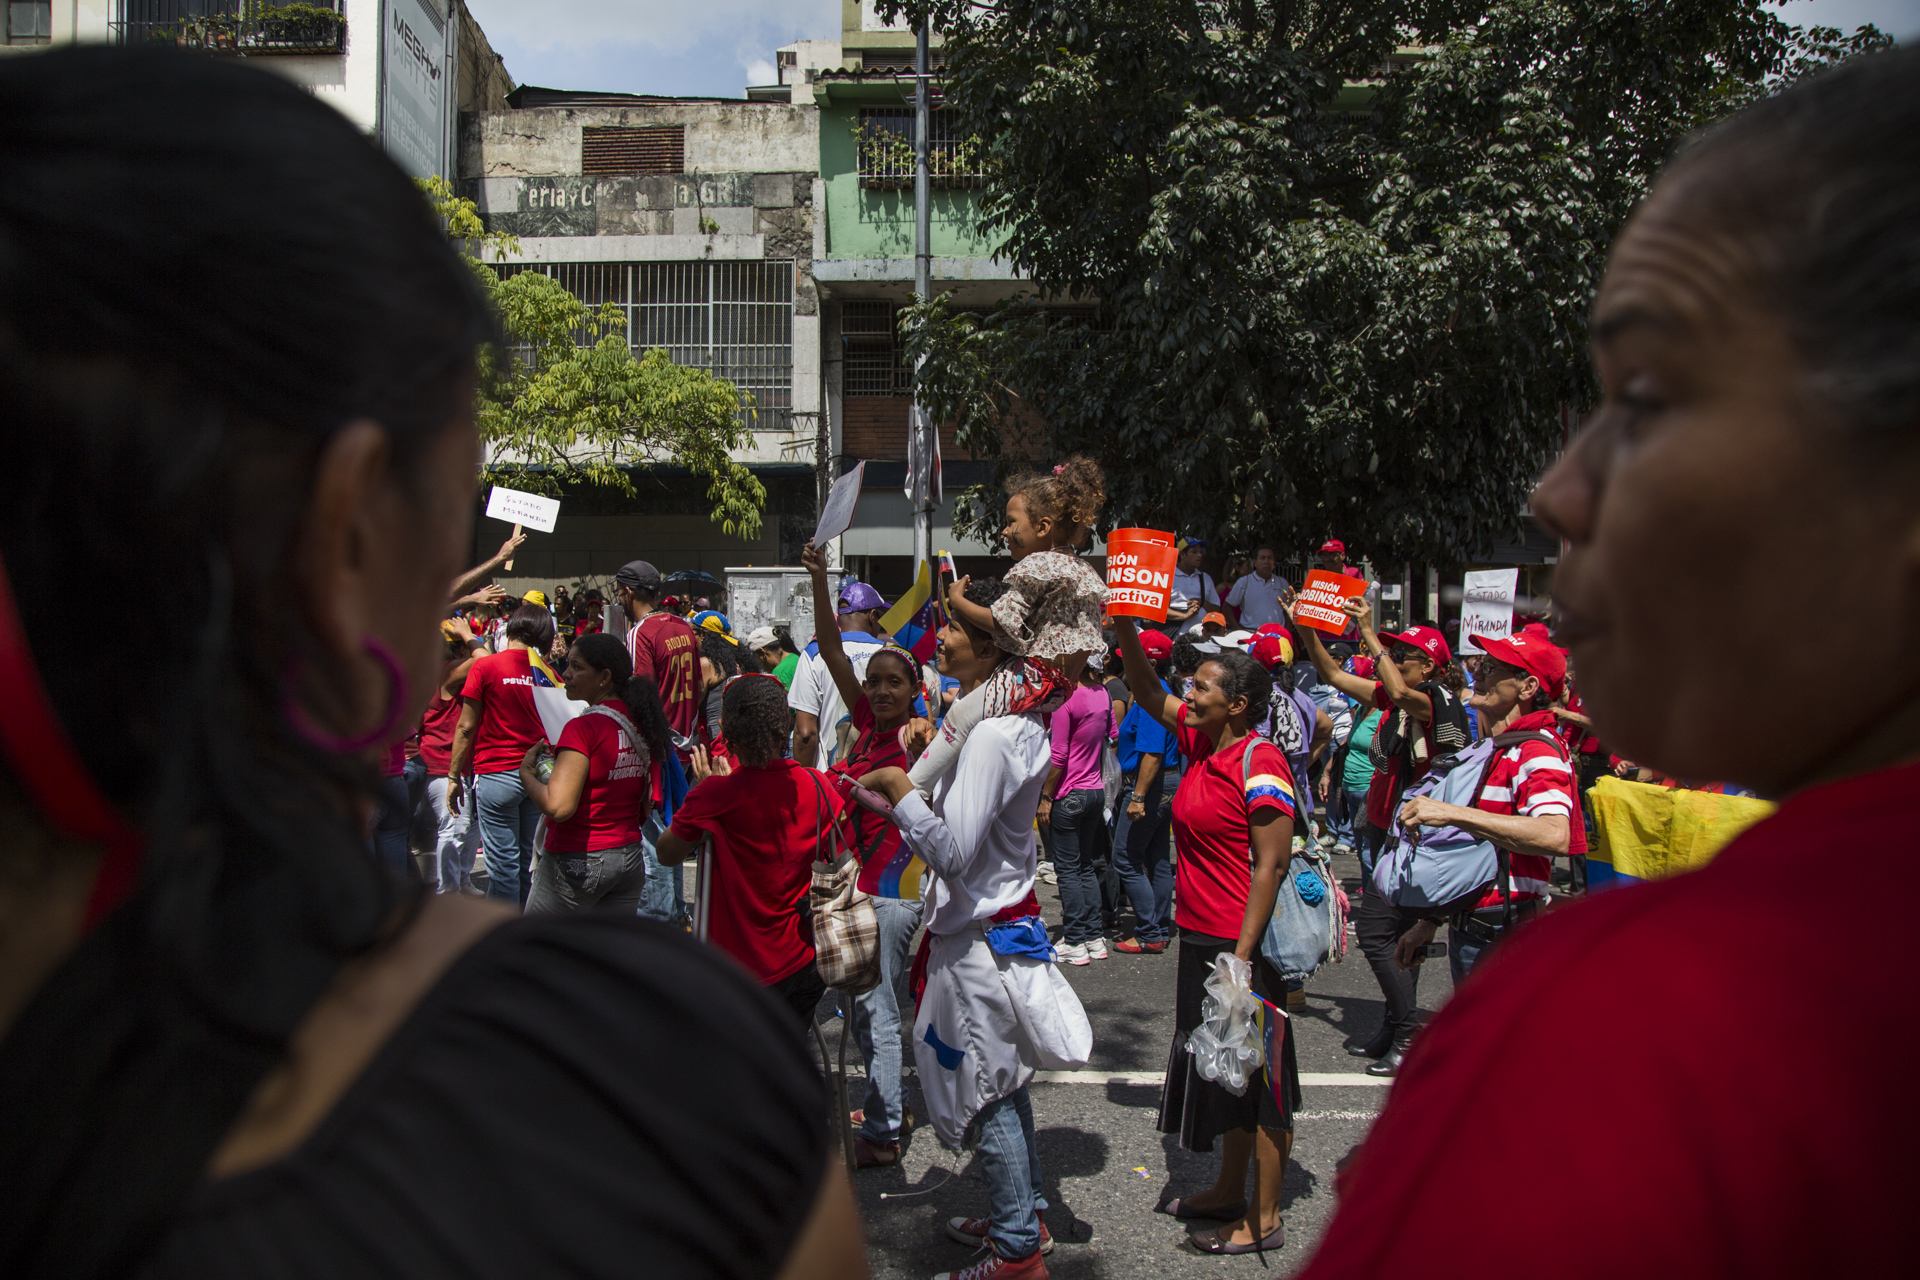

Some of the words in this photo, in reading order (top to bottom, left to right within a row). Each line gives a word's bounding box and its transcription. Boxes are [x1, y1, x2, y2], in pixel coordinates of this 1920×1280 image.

[393, 33, 437, 108] WATTS
[391, 94, 437, 158] MATERIALES
[391, 118, 437, 176] ELÉCTRICOS
[1108, 590, 1160, 607] uctiva
[1311, 580, 1341, 594] MISIÓN
[1466, 589, 1508, 603] ESTADO
[1298, 604, 1343, 624] Productiva
[670, 651, 693, 704] 23
